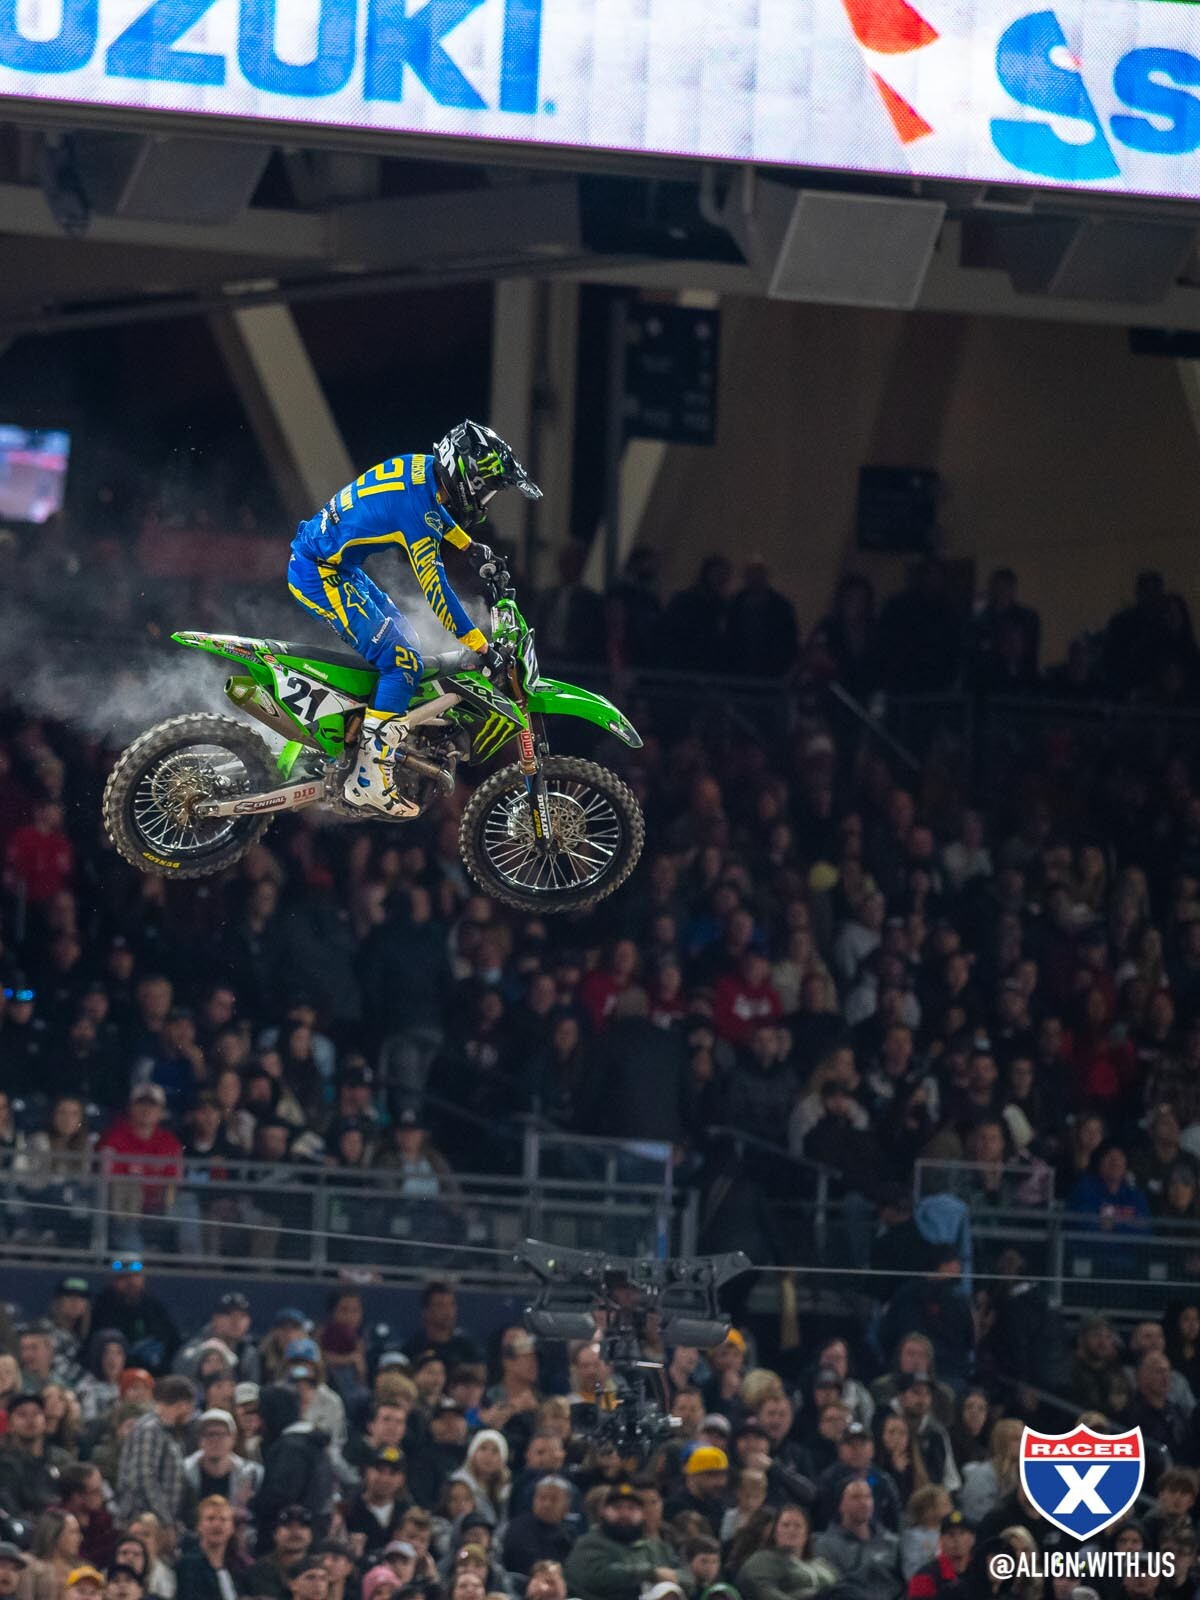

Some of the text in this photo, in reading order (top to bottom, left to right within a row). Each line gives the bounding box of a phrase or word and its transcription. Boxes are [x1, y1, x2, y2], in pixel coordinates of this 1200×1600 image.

[395, 645, 419, 672] 21
[281, 676, 330, 722] 21
[537, 794, 551, 839] DUNLOP
[143, 851, 182, 869] DUNLOP
